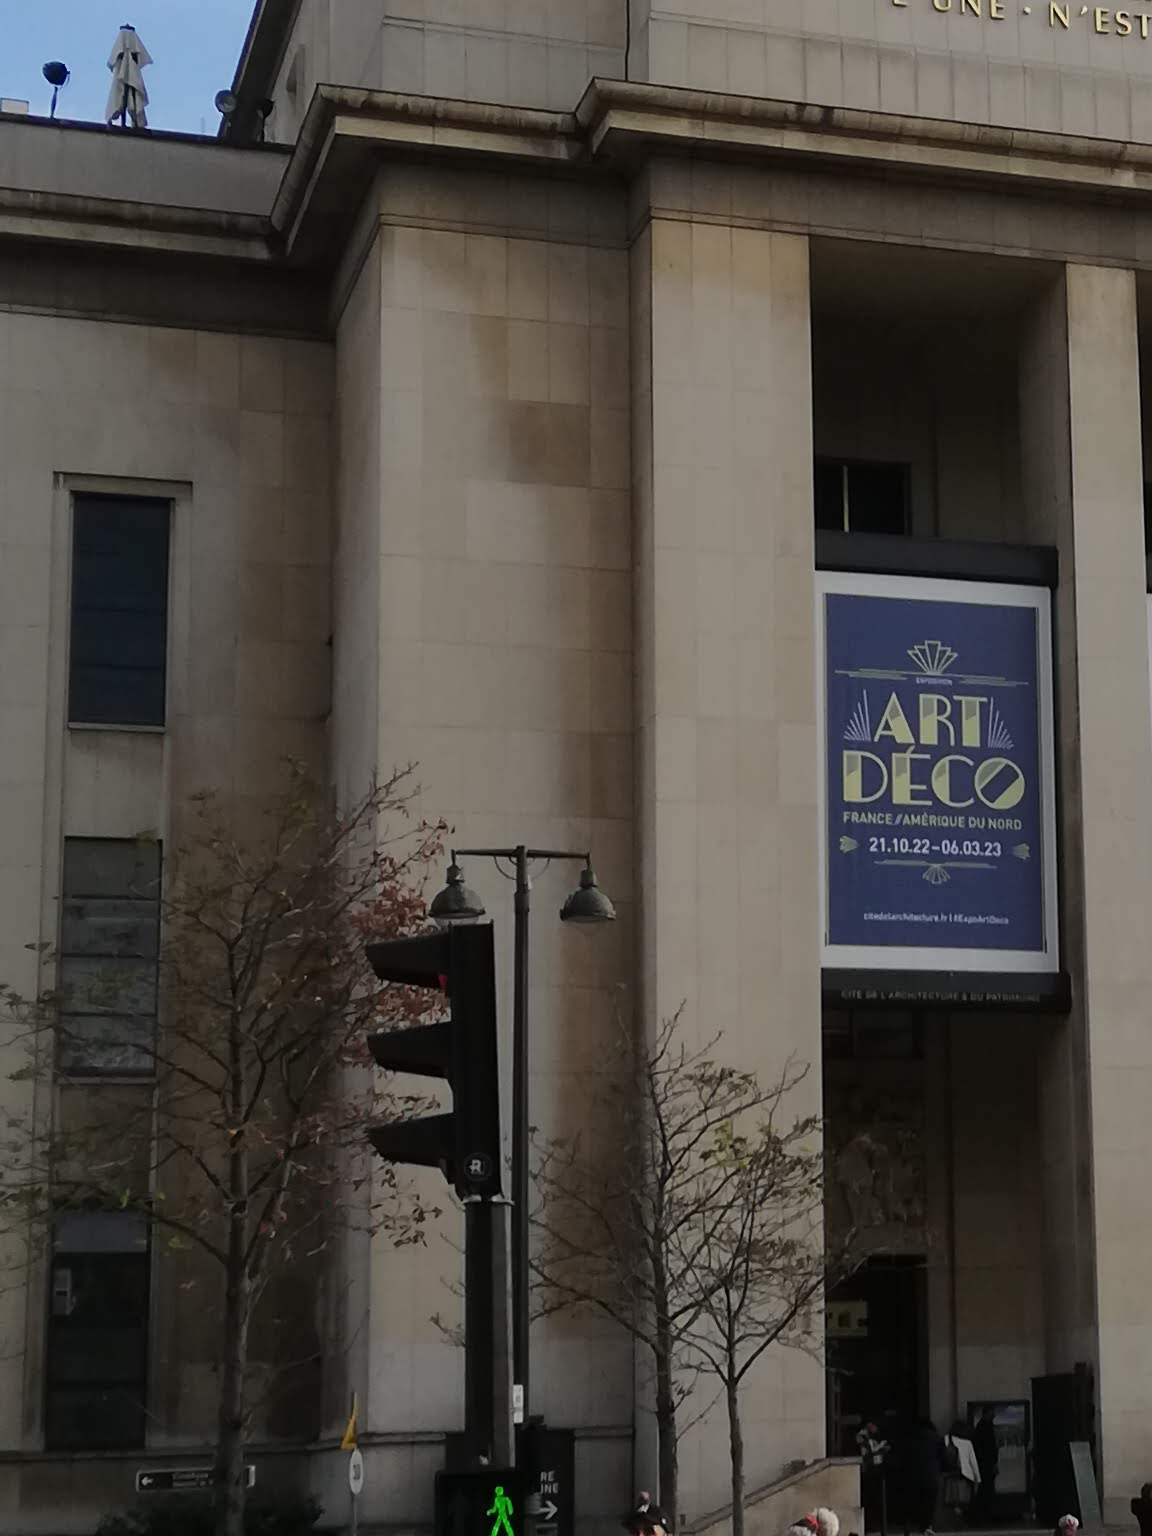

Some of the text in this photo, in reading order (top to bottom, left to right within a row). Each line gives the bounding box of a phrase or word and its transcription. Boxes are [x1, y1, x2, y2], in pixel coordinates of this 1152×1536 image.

[1050, 1, 1152, 39] N'EST
[874, 691, 988, 749] ART
[842, 744, 1026, 811] DÉCO
[968, 817, 985, 828] DU
[988, 818, 1022, 831] NORD
